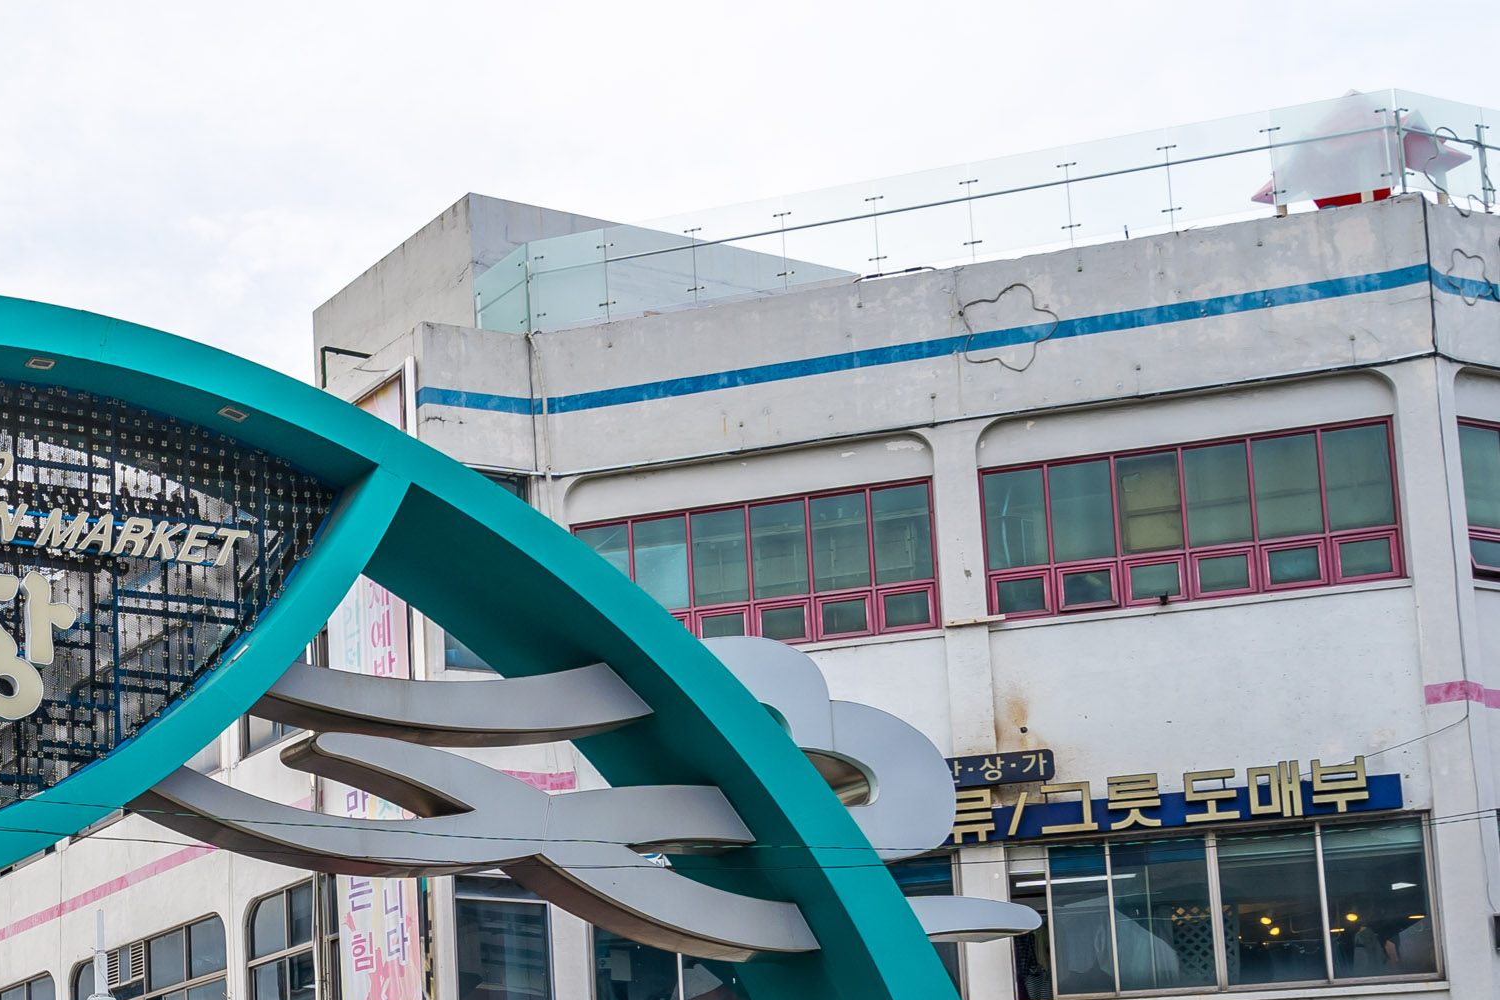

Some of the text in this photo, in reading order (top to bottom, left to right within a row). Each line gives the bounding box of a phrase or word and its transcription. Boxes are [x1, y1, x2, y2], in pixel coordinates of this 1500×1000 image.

[35, 506, 250, 568] MARKET
[1183, 755, 1370, 824] 도매부
[351, 931, 375, 972] 힘
